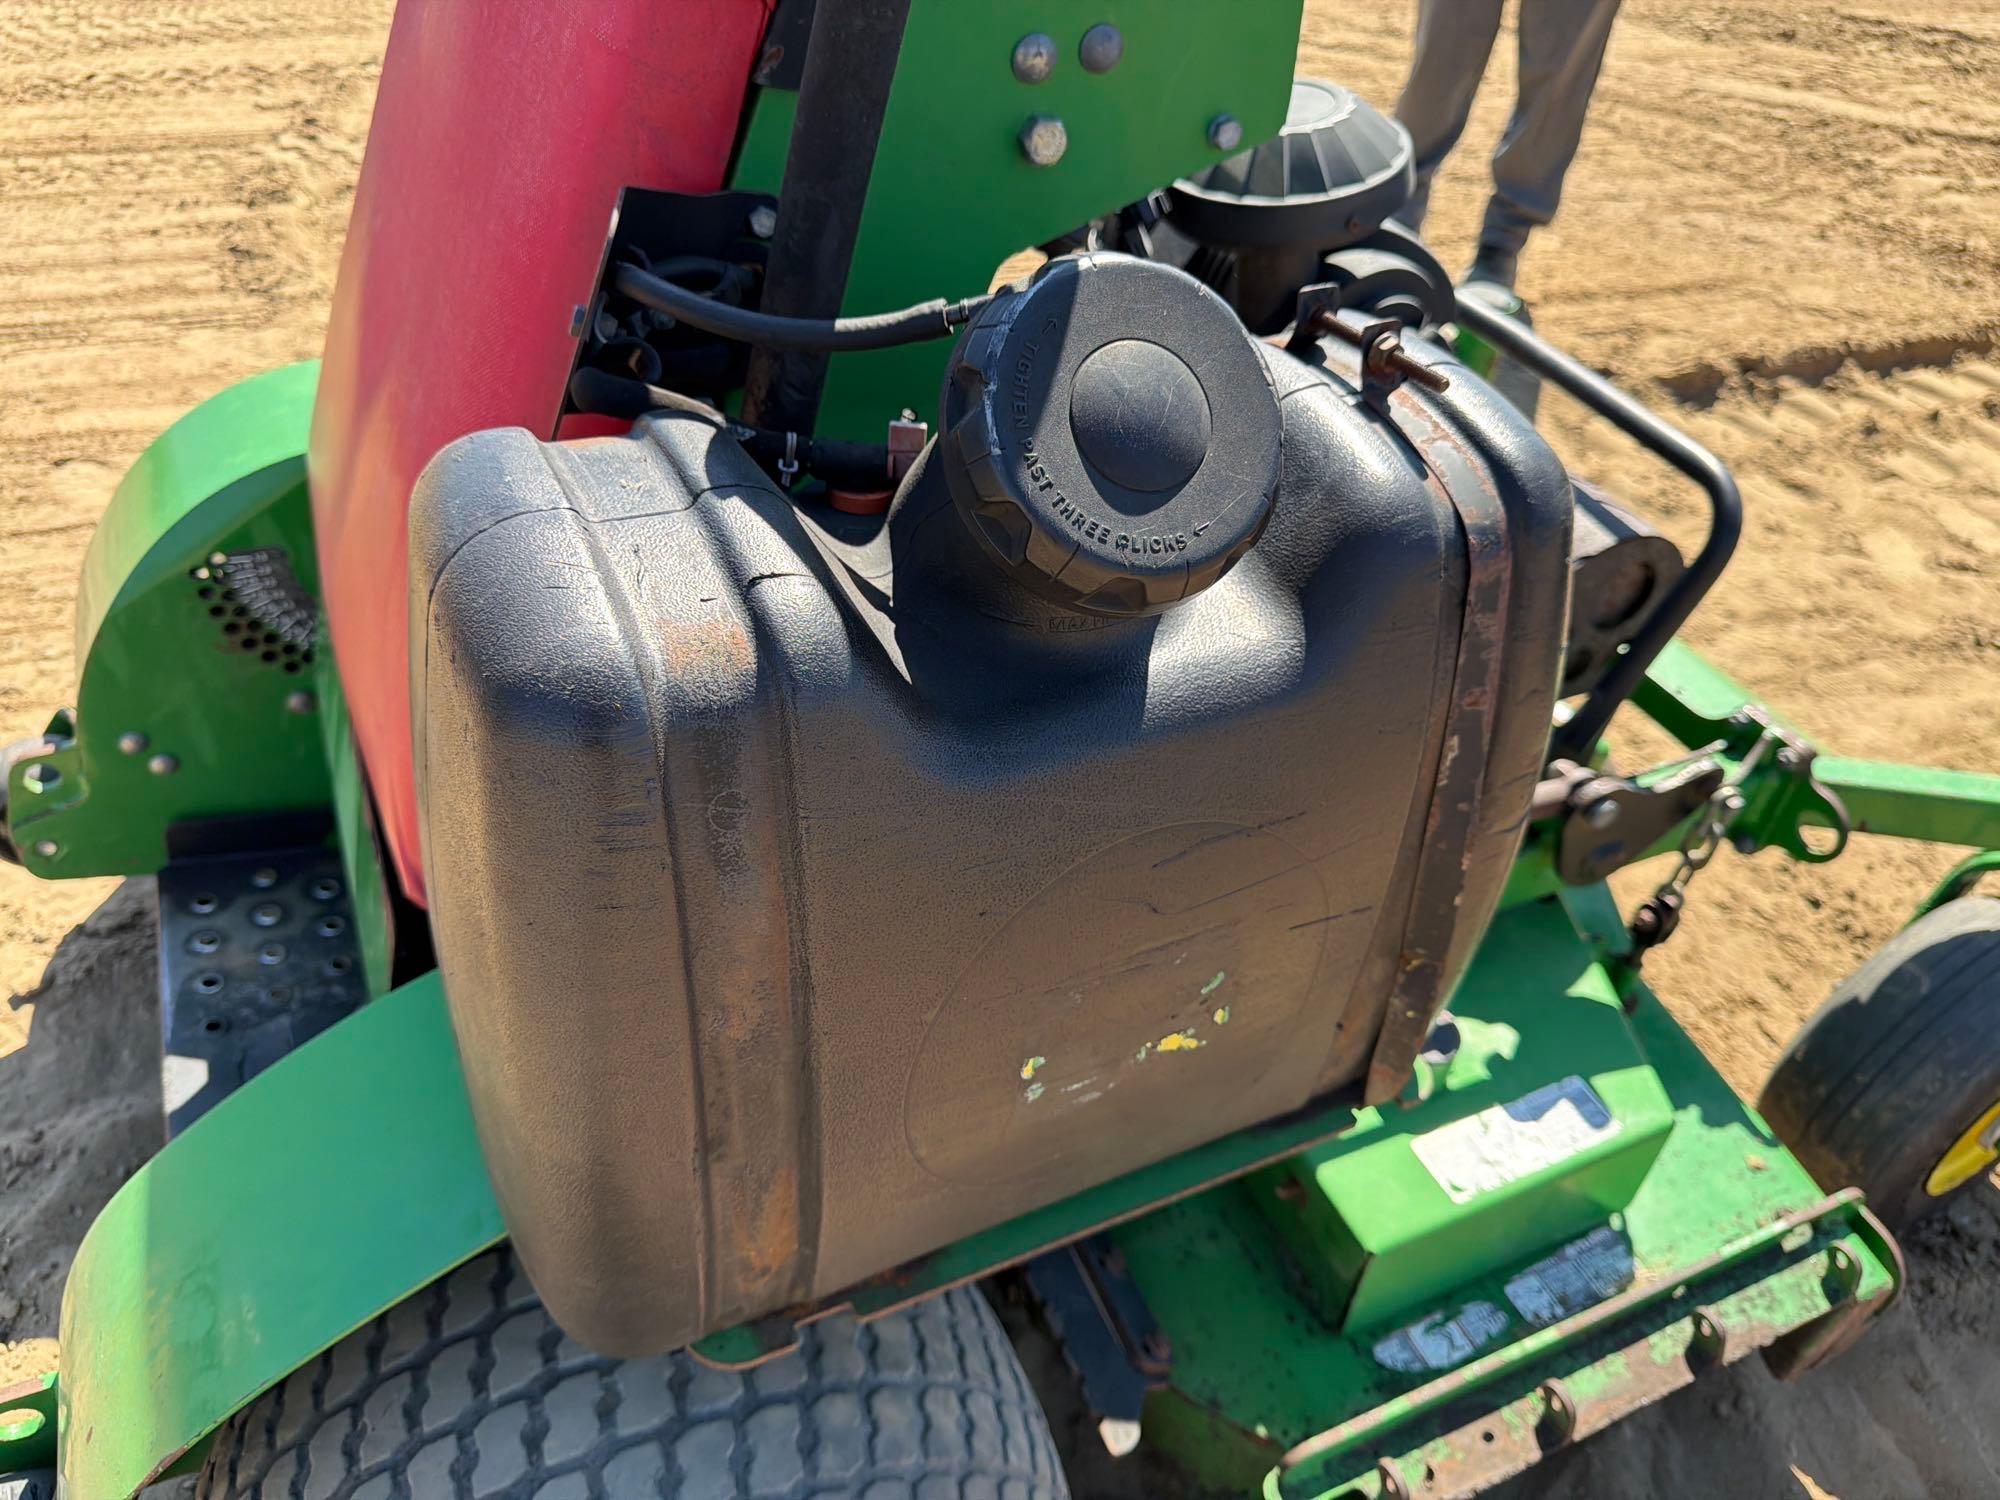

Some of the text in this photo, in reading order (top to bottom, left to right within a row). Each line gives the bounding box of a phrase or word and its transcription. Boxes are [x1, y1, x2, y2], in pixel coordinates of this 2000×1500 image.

[1014, 341, 1188, 554] TIGHTEN PAST THREE CLICKS
